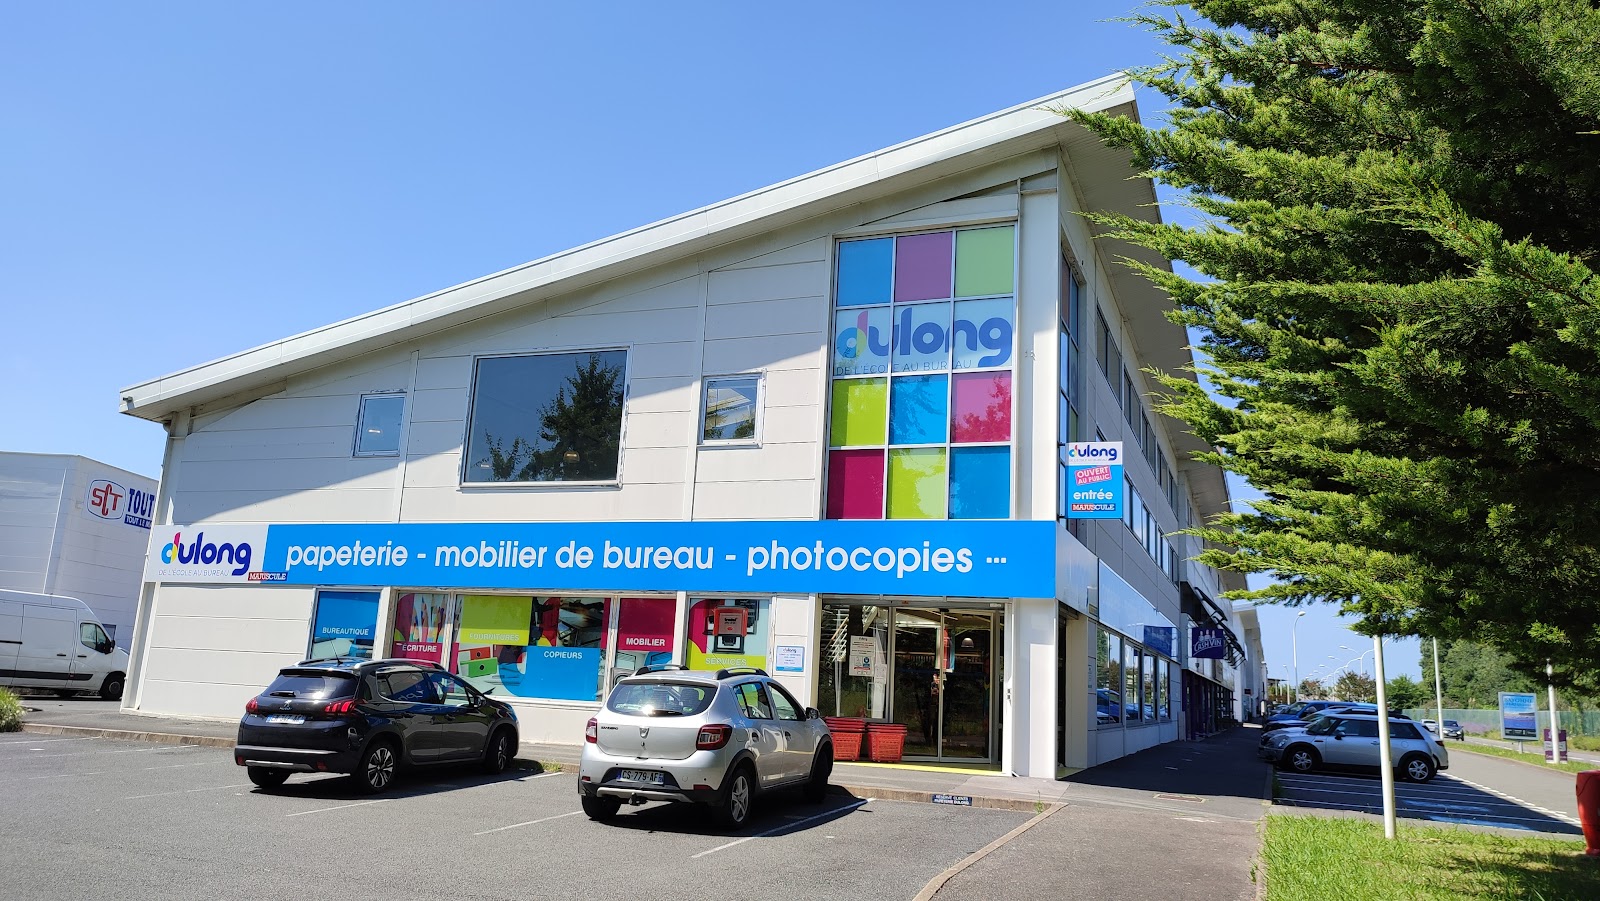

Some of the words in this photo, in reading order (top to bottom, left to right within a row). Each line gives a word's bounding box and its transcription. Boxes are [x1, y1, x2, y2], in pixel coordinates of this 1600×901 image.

[837, 307, 1013, 368] dulong
[836, 366, 850, 375] DE
[903, 363, 919, 372] AU
[924, 360, 971, 371] BURAU
[1069, 444, 1118, 461] dulong
[1077, 466, 1108, 478] OUVERT
[1077, 477, 1087, 485] AU
[1088, 474, 1110, 483] PUBLIC
[1073, 488, 1114, 500] entrée
[1072, 503, 1115, 511] MAJUSCULE
[161, 531, 252, 576] dulong
[285, 540, 408, 572] papeterie
[434, 540, 548, 569] mobilier
[554, 540, 594, 569] de
[603, 540, 714, 570] bureau
[747, 539, 973, 578] photocopies
[203, 569, 230, 577] BUREAU
[249, 572, 287, 581] MAJUSCULE
[322, 626, 370, 636] BUREAUTIQUE
[469, 633, 520, 642] FOURNITURES
[626, 636, 666, 647] MOBILIER
[402, 642, 437, 653] ÉCRITURE
[543, 650, 583, 660] COPIEURS
[705, 657, 747, 666] SERVICES
[622, 770, 659, 782] CS-779-AF
